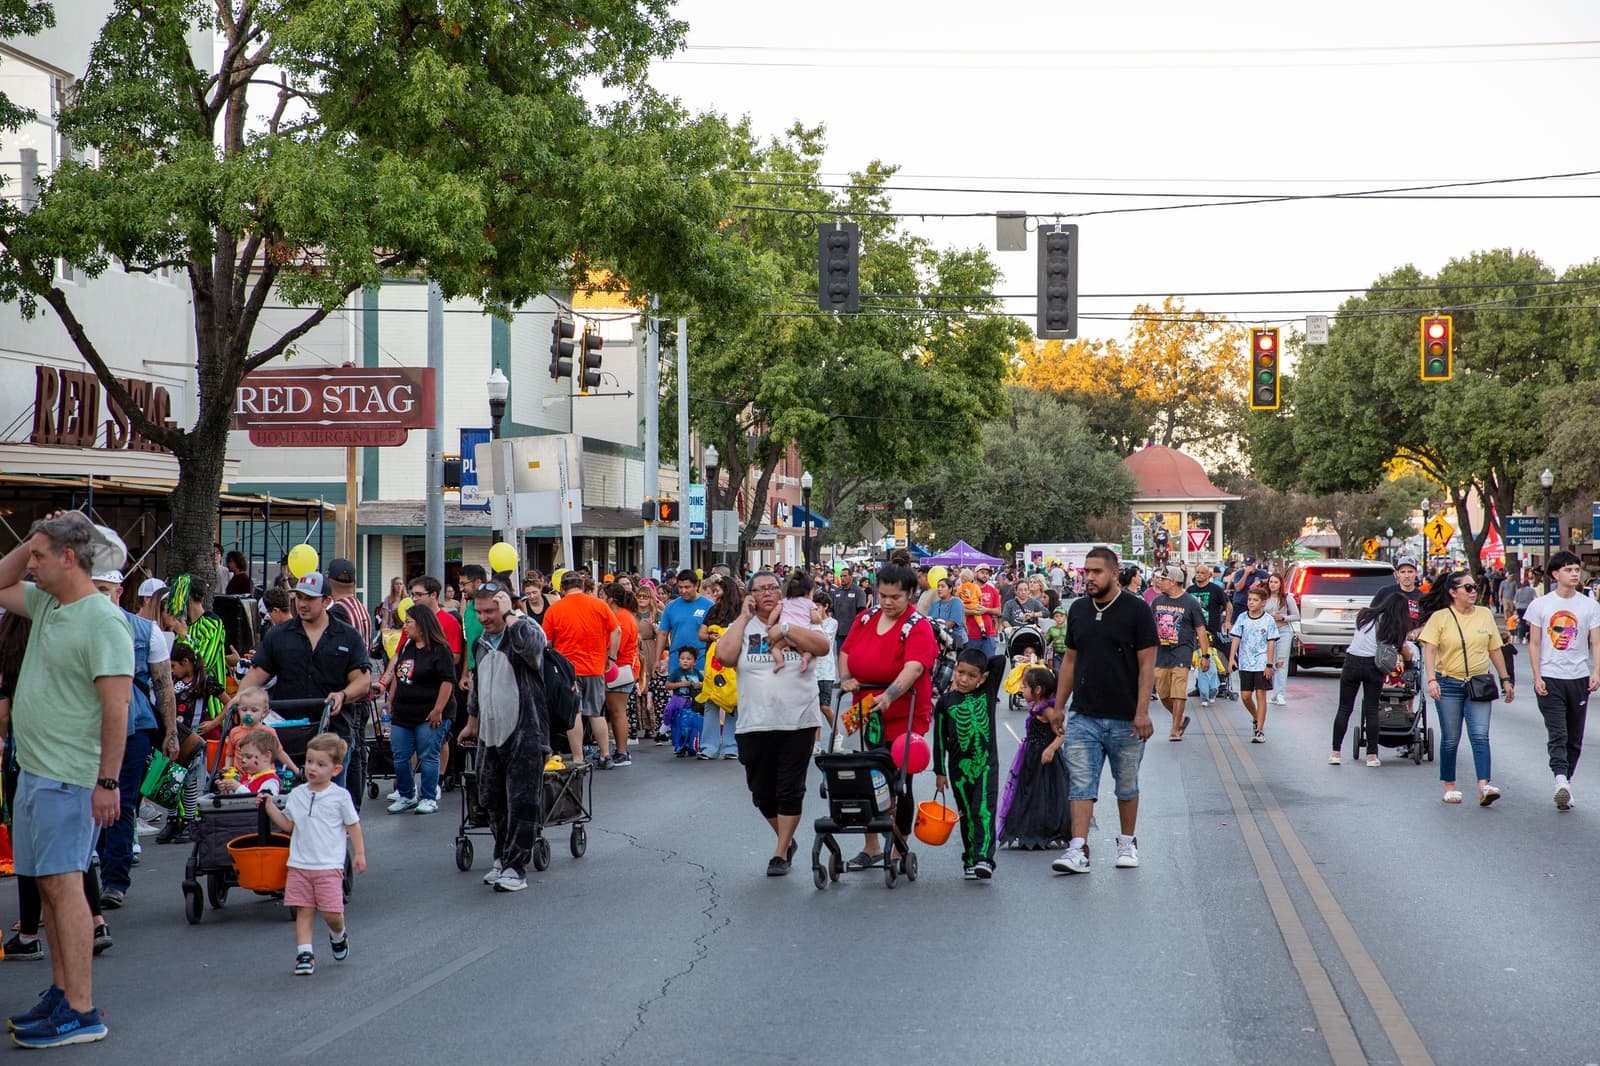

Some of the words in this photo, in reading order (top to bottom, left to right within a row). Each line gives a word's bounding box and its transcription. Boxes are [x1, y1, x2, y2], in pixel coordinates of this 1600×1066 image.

[30, 365, 100, 448] RED
[233, 386, 312, 414] RED
[322, 385, 415, 414] STAG
[256, 431, 298, 443] HOME
[301, 430, 396, 443] MERCANTILE
[689, 495, 704, 506] DINE
